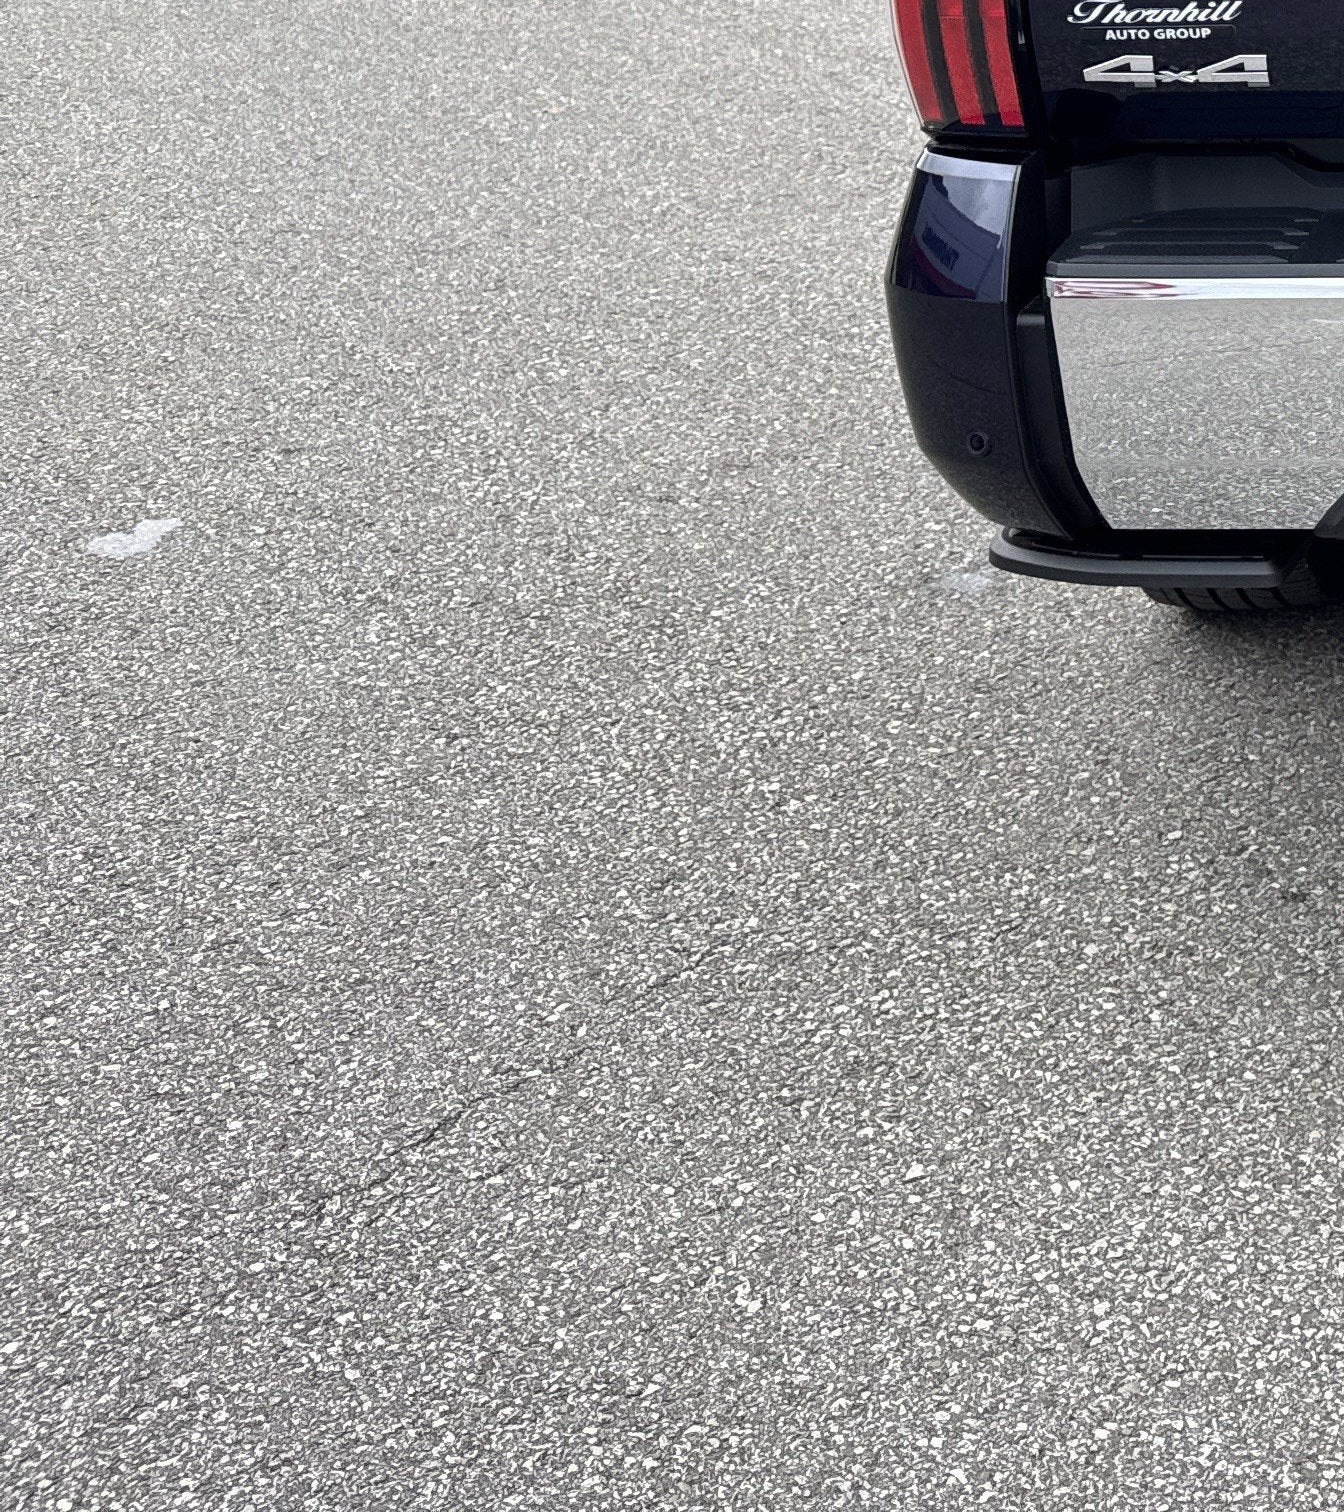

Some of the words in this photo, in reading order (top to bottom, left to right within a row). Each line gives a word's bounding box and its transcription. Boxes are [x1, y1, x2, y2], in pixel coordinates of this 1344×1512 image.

[1105, 28, 1150, 41] AUTO
[1153, 27, 1212, 40] GROUP
[1083, 54, 1271, 88] 4x4
